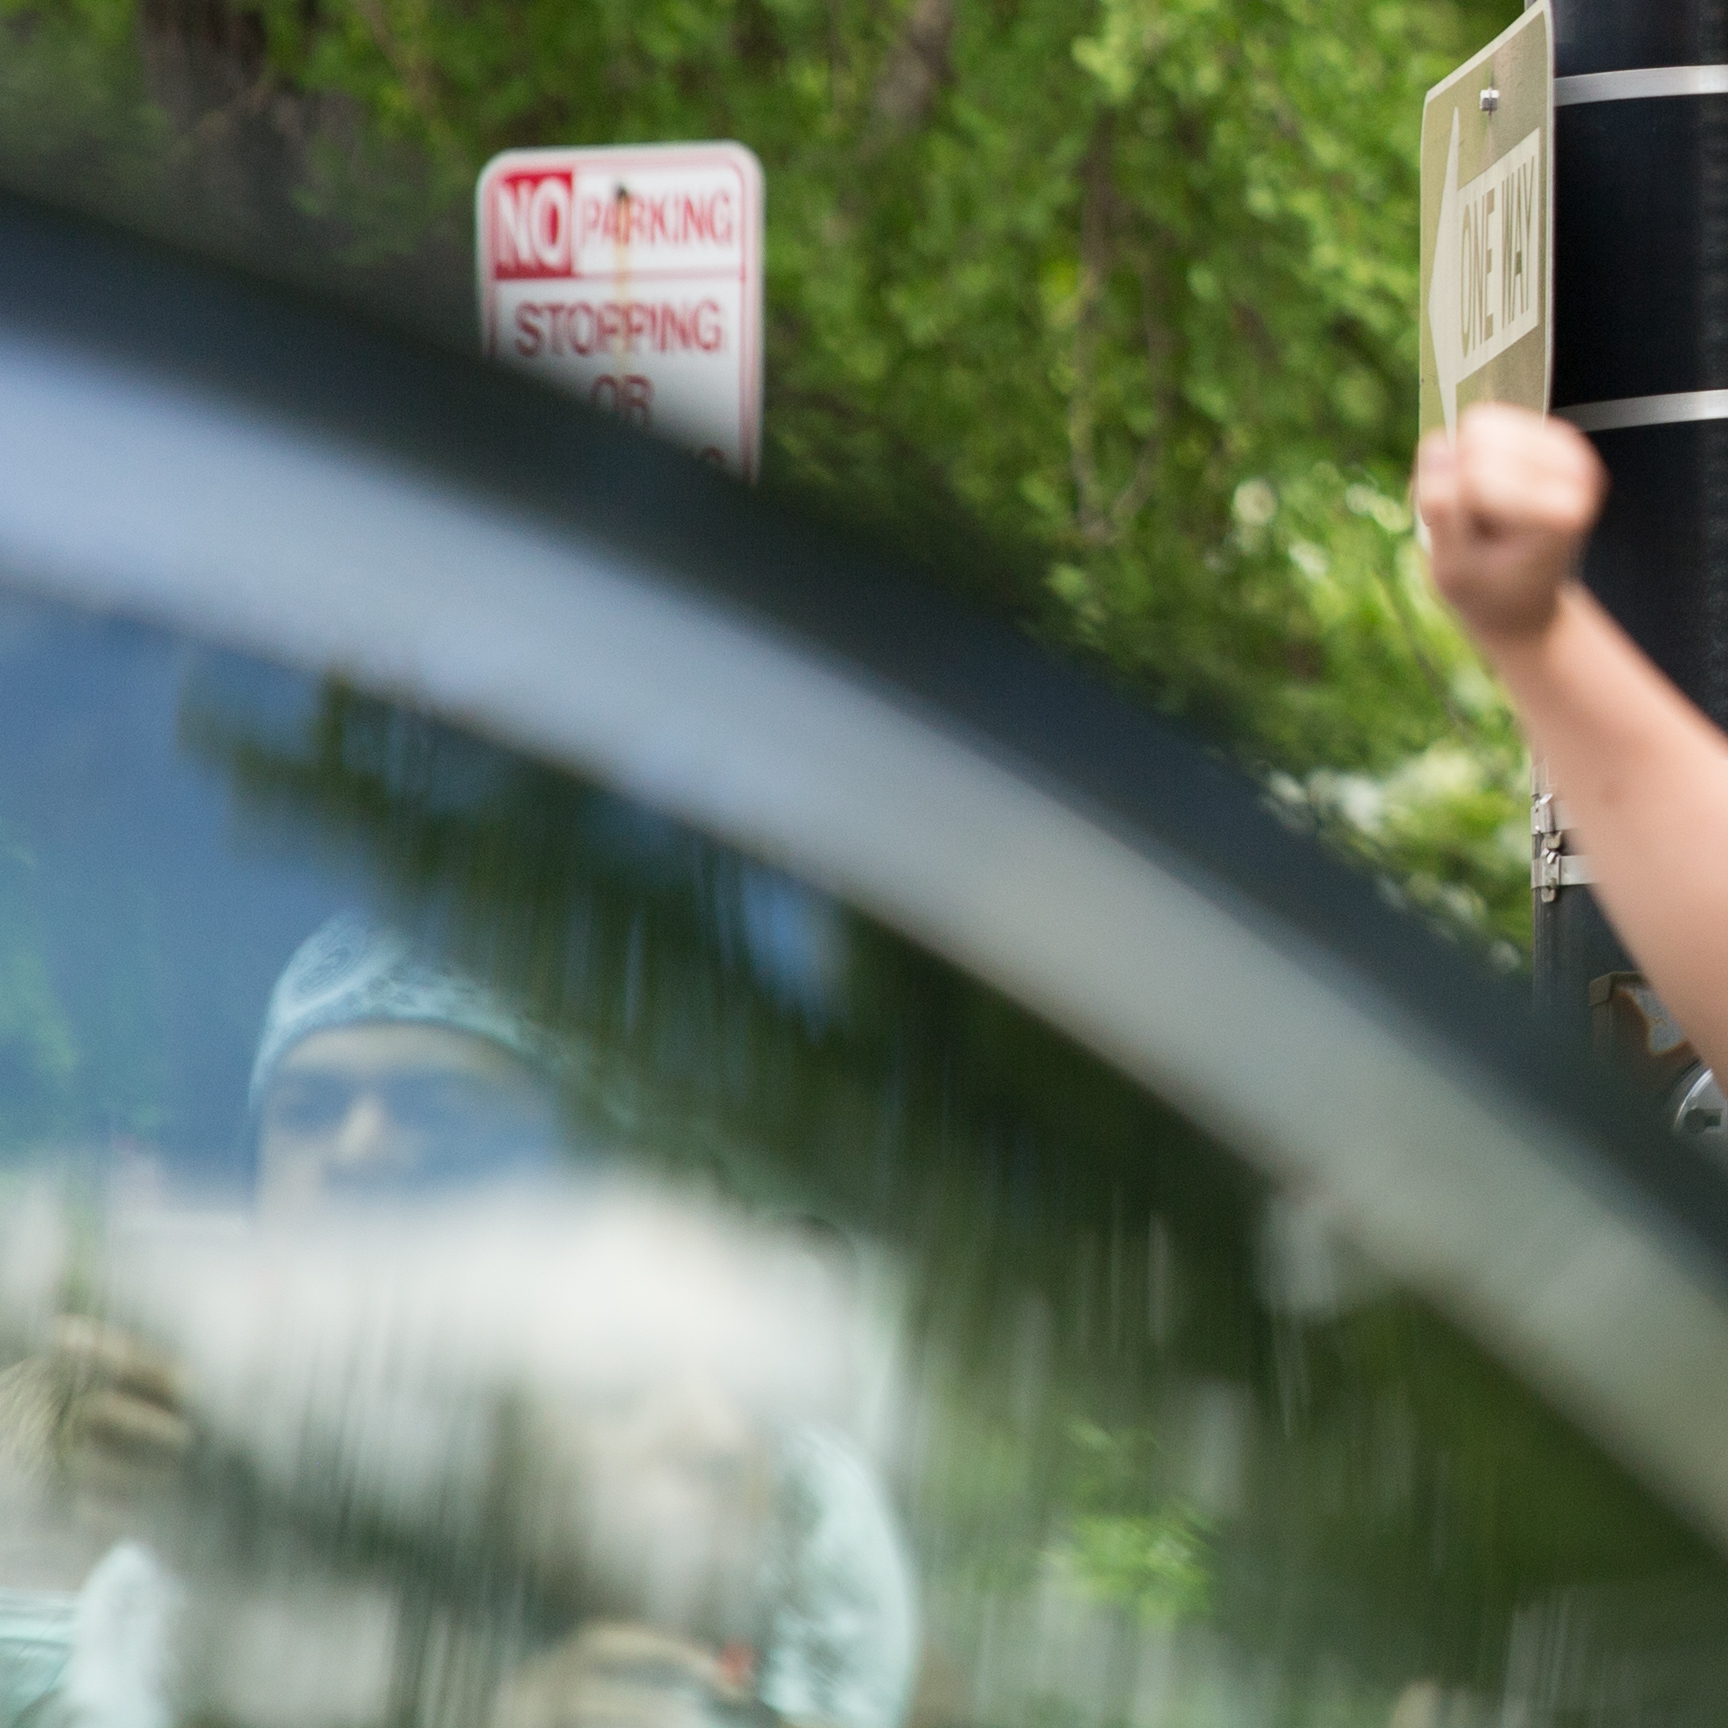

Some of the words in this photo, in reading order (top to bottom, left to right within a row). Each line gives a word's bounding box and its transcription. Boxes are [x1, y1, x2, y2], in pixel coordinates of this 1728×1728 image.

[500, 175, 569, 270] NO
[584, 190, 733, 249] PARKING
[1459, 187, 1496, 359] ONE
[1501, 155, 1536, 330] WAY
[514, 298, 723, 358] STOPPING
[590, 374, 655, 433] OR
